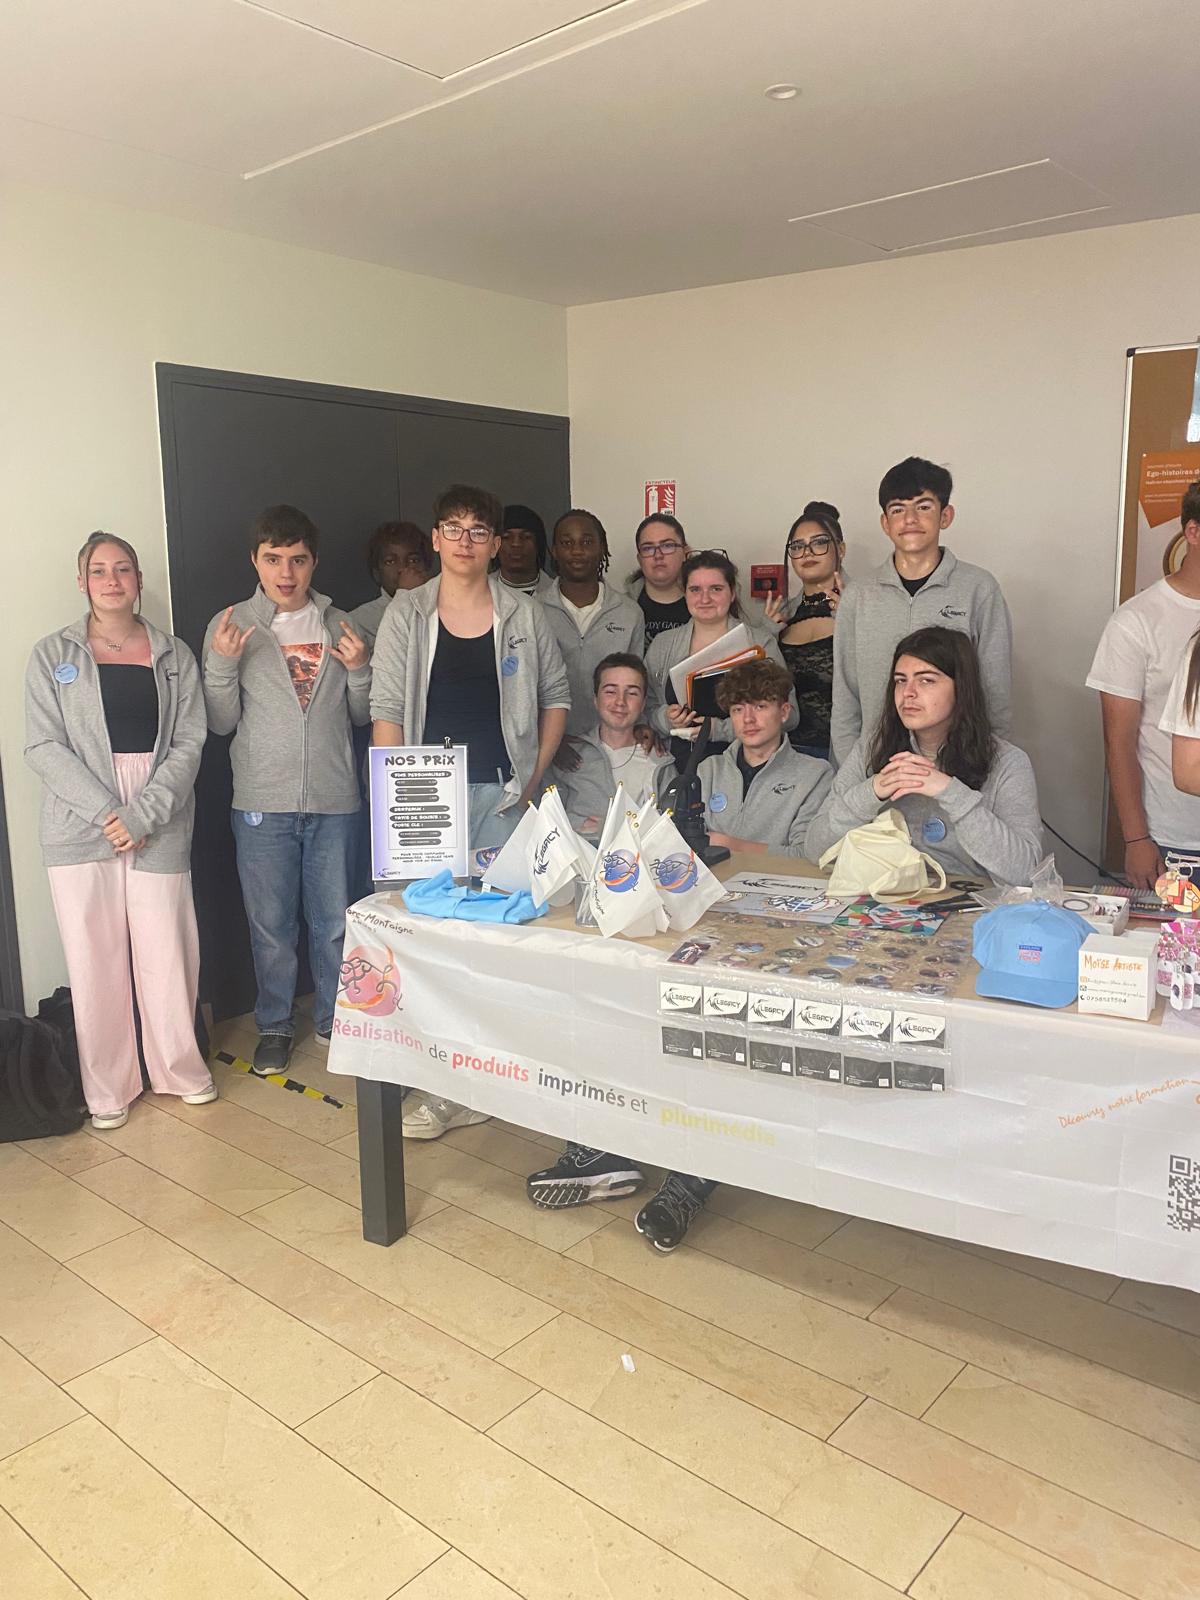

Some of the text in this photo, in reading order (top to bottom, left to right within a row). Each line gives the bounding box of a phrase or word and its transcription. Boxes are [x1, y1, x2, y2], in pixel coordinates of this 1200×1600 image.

[385, 755, 416, 766] NOS
[539, 826, 561, 864] LEGACY
[671, 993, 696, 1003] LEGACY
[716, 999, 741, 1009] LEGACY
[760, 1005, 786, 1017] LEGACY
[807, 1012, 835, 1024] LEGACY
[907, 1023, 938, 1036] LEGACY
[333, 1018, 423, 1051] Réalisation
[428, 1044, 448, 1062] de
[452, 1052, 529, 1082] produits
[538, 1068, 626, 1108] imprimés
[630, 1097, 648, 1115] et
[1135, 1078, 1187, 1104] formation
